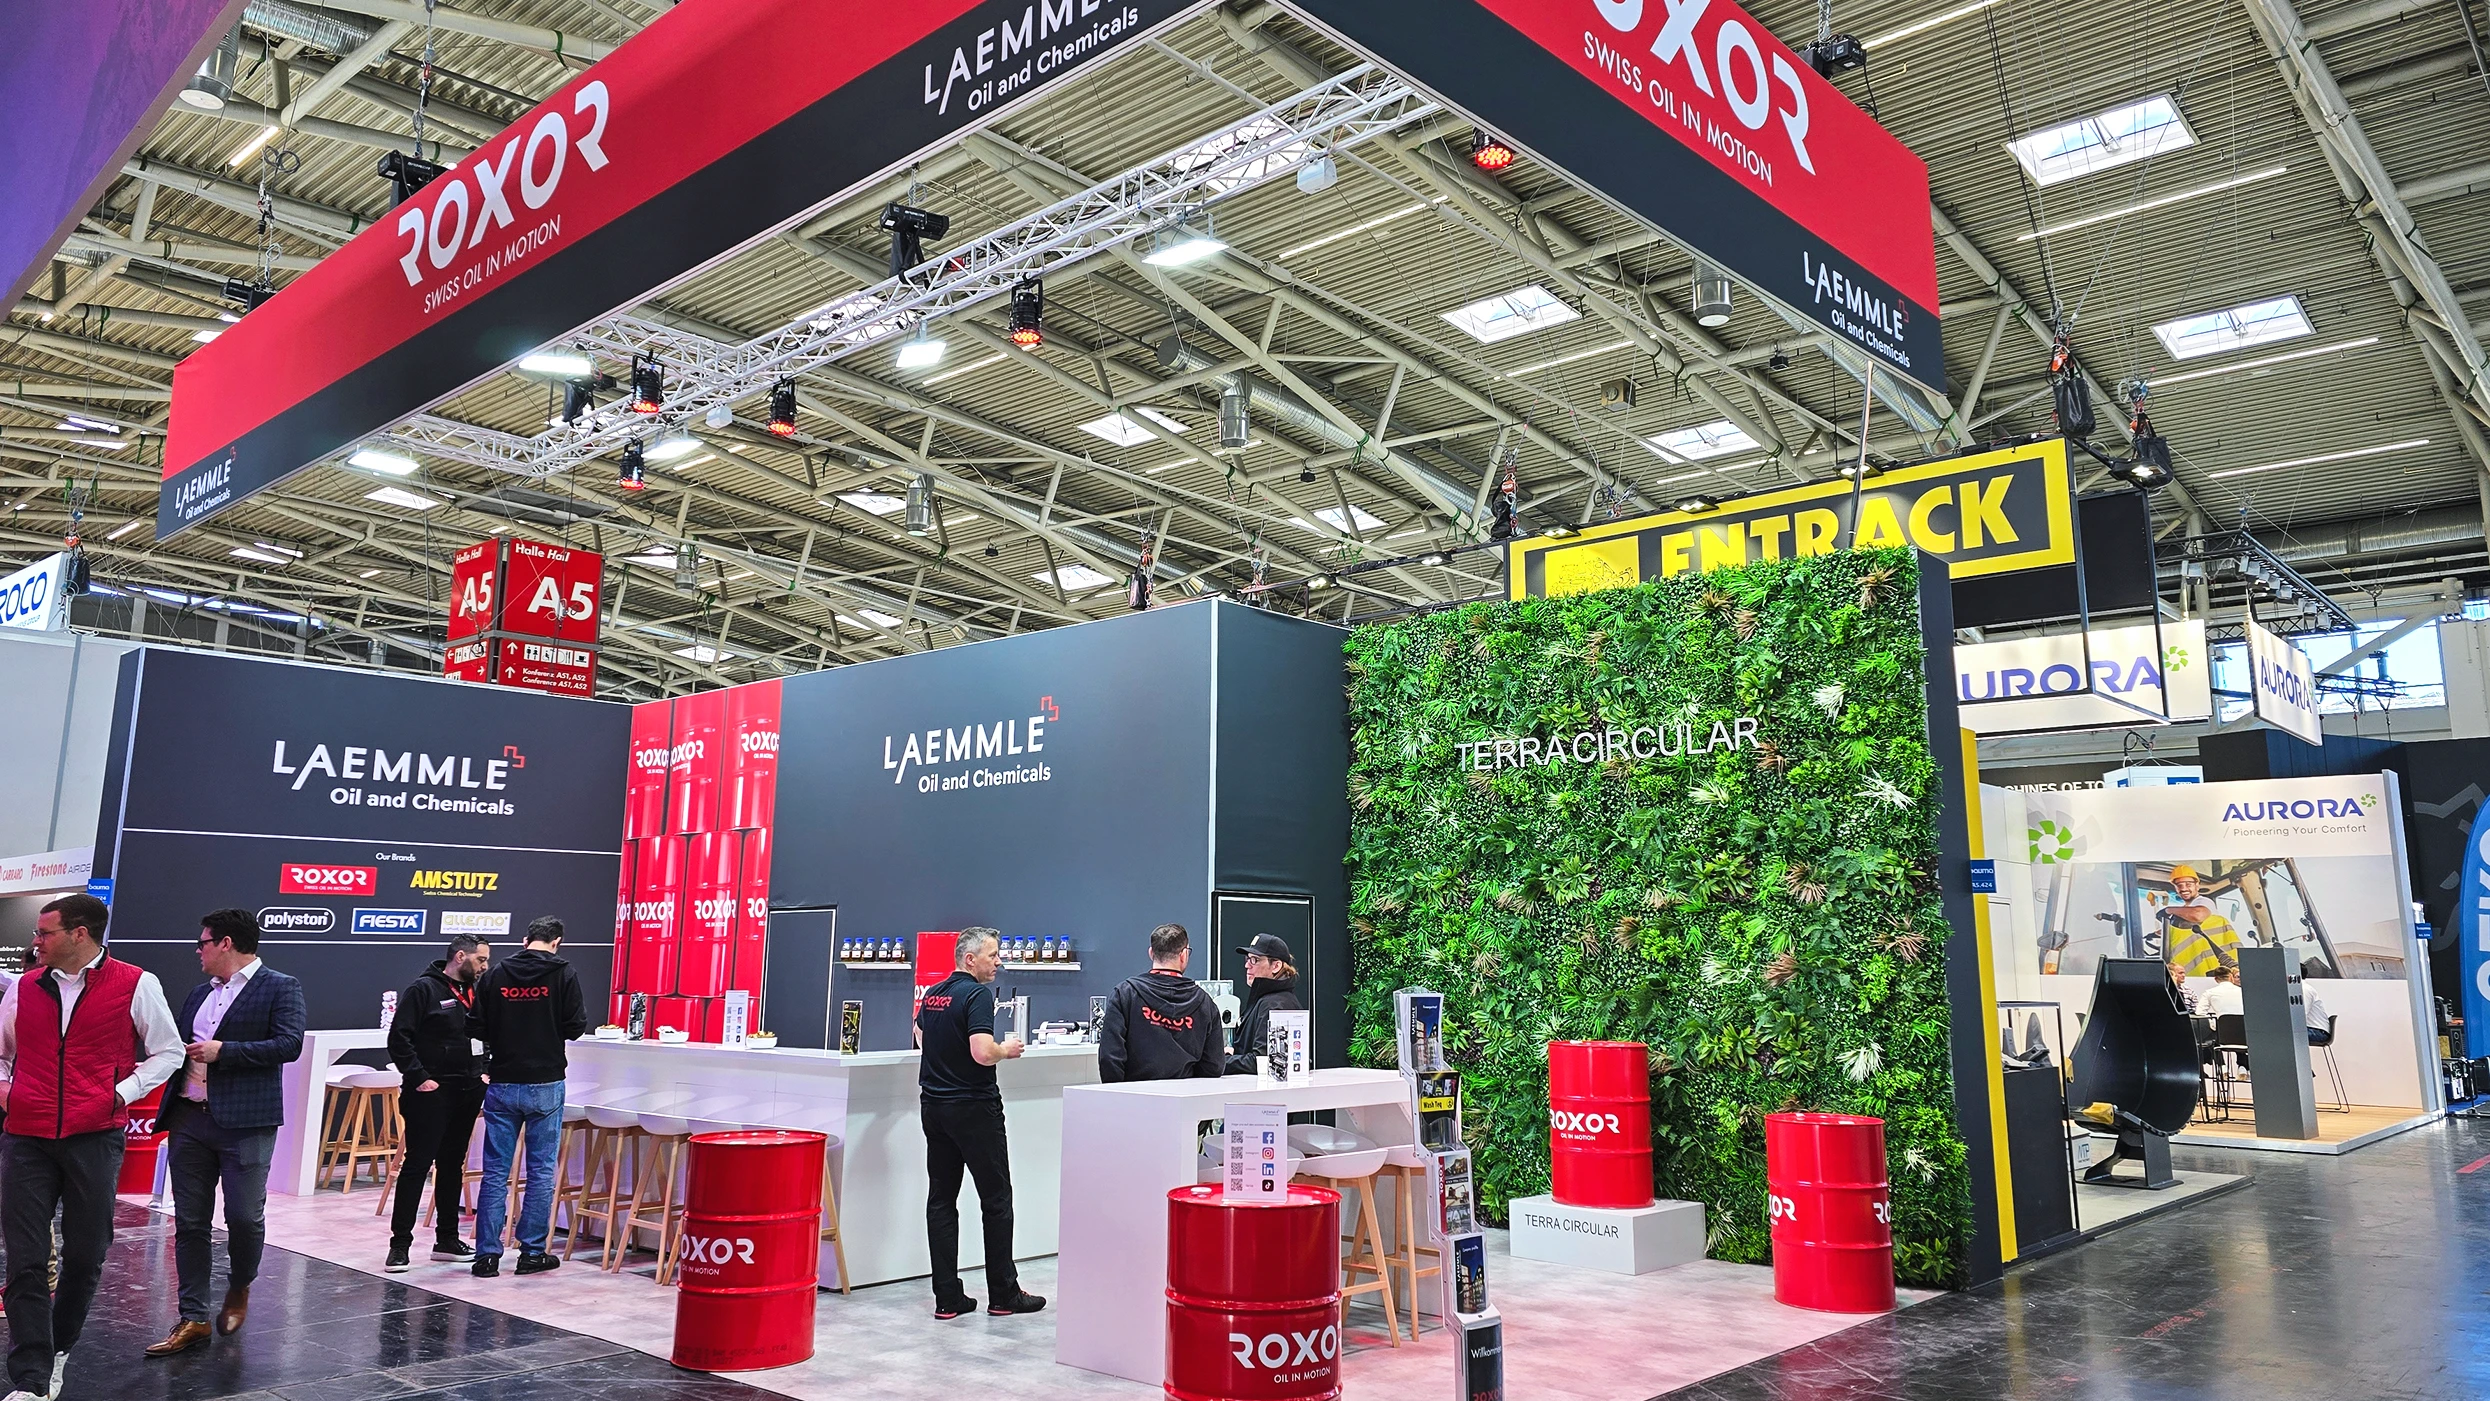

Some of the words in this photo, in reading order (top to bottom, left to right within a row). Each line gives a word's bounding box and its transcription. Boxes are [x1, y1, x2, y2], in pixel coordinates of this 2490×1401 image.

[925, 0, 1117, 115] LAEMM
[967, 81, 992, 111] Oil
[998, 60, 1031, 96] and
[1037, 6, 1138, 74] Chemicals
[1592, 0, 1816, 176] XOR
[1584, 30, 1642, 93] SWISS
[1649, 79, 1677, 119] OIL
[1682, 101, 1701, 137] IN
[1707, 118, 1772, 187] MOTION
[398, 80, 610, 287] ROXOR
[424, 277, 460, 313] SWISS
[463, 263, 482, 290] OIL
[486, 251, 500, 277] IN
[504, 214, 561, 267] MOTION
[1803, 250, 1904, 341] LAEMMLE
[1831, 309, 1845, 330] Oil
[1847, 322, 1864, 341] and
[1866, 330, 1910, 368] Chemicals
[175, 458, 232, 517] LAEMMLE
[185, 505, 193, 520] Oil
[193, 501, 203, 516] and
[204, 488, 231, 510] Chemicals
[1661, 474, 2020, 578] ENTRACK
[455, 551, 471, 564] Halle
[470, 547, 483, 560] Hall
[515, 543, 545, 558] Halle
[547, 549, 570, 562] Hall
[458, 570, 493, 618] A5
[527, 576, 594, 621] A5
[522, 668, 554, 677] Konferenz
[522, 676, 557, 686] Conference
[1961, 656, 2162, 700] URORA
[2261, 655, 2312, 714] AURORA
[670, 740, 704, 767] OXOR
[883, 715, 1045, 784] LAEMMLE
[273, 740, 509, 791] LAEMMLE
[918, 773, 938, 793] Oil
[941, 769, 969, 792] and
[972, 762, 1051, 788] Chemicals
[330, 787, 362, 805] Oil
[367, 791, 406, 809] and
[412, 793, 515, 816] Chemicals
[2222, 797, 2365, 822] AURORA
[2233, 826, 2290, 837] Pioneering
[2292, 826, 2318, 835] Your
[2321, 824, 2367, 834] Comfort
[375, 852, 391, 860] Our
[391, 853, 416, 861] Brands
[30, 863, 68, 881] Firestone
[290, 867, 367, 886] ROXOR
[410, 870, 499, 890] AMSTUTZ
[264, 911, 328, 928] polyston
[359, 915, 418, 928] FIESTA
[634, 901, 674, 921] ROXOR
[694, 899, 736, 920] ROXOR
[747, 898, 768, 918] RO
[500, 986, 549, 997] ROXOR
[1525, 1214, 1560, 1230] TERRA
[1563, 1218, 1619, 1239] CIRCULAR
[1873, 1201, 1891, 1224] RO
[681, 1234, 755, 1264] OXOR
[694, 1267, 720, 1275] MOTION
[1229, 1321, 1342, 1369] ROXO
[1274, 1373, 1288, 1384] OIL
[1291, 1372, 1300, 1382] IN
[1303, 1366, 1331, 1383] MOTION
